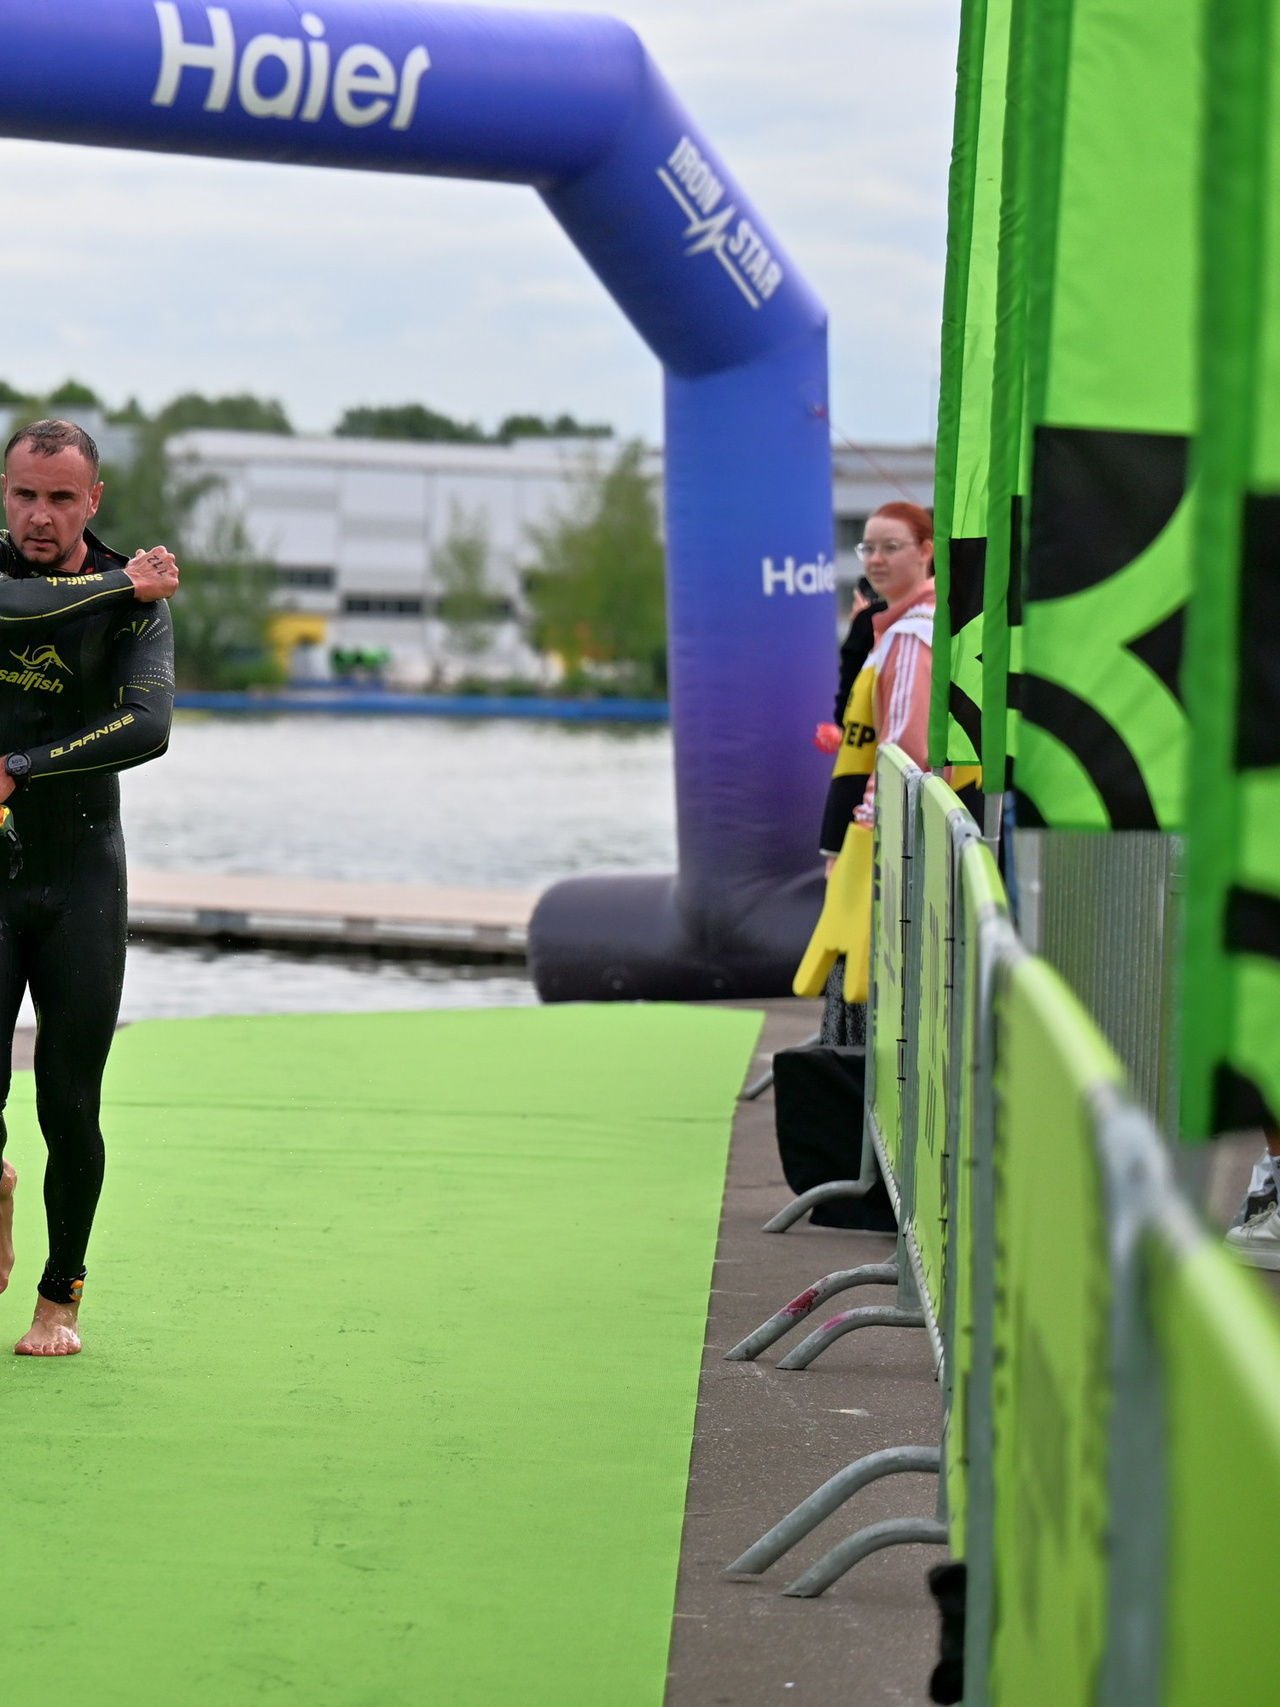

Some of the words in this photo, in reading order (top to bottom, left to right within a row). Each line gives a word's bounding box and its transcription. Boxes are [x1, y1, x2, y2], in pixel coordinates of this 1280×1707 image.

[151, 0, 431, 131] Haier
[667, 135, 725, 215] IRON
[727, 219, 783, 300] STAR
[147, 554, 168, 576] 112
[762, 552, 836, 597] Haie
